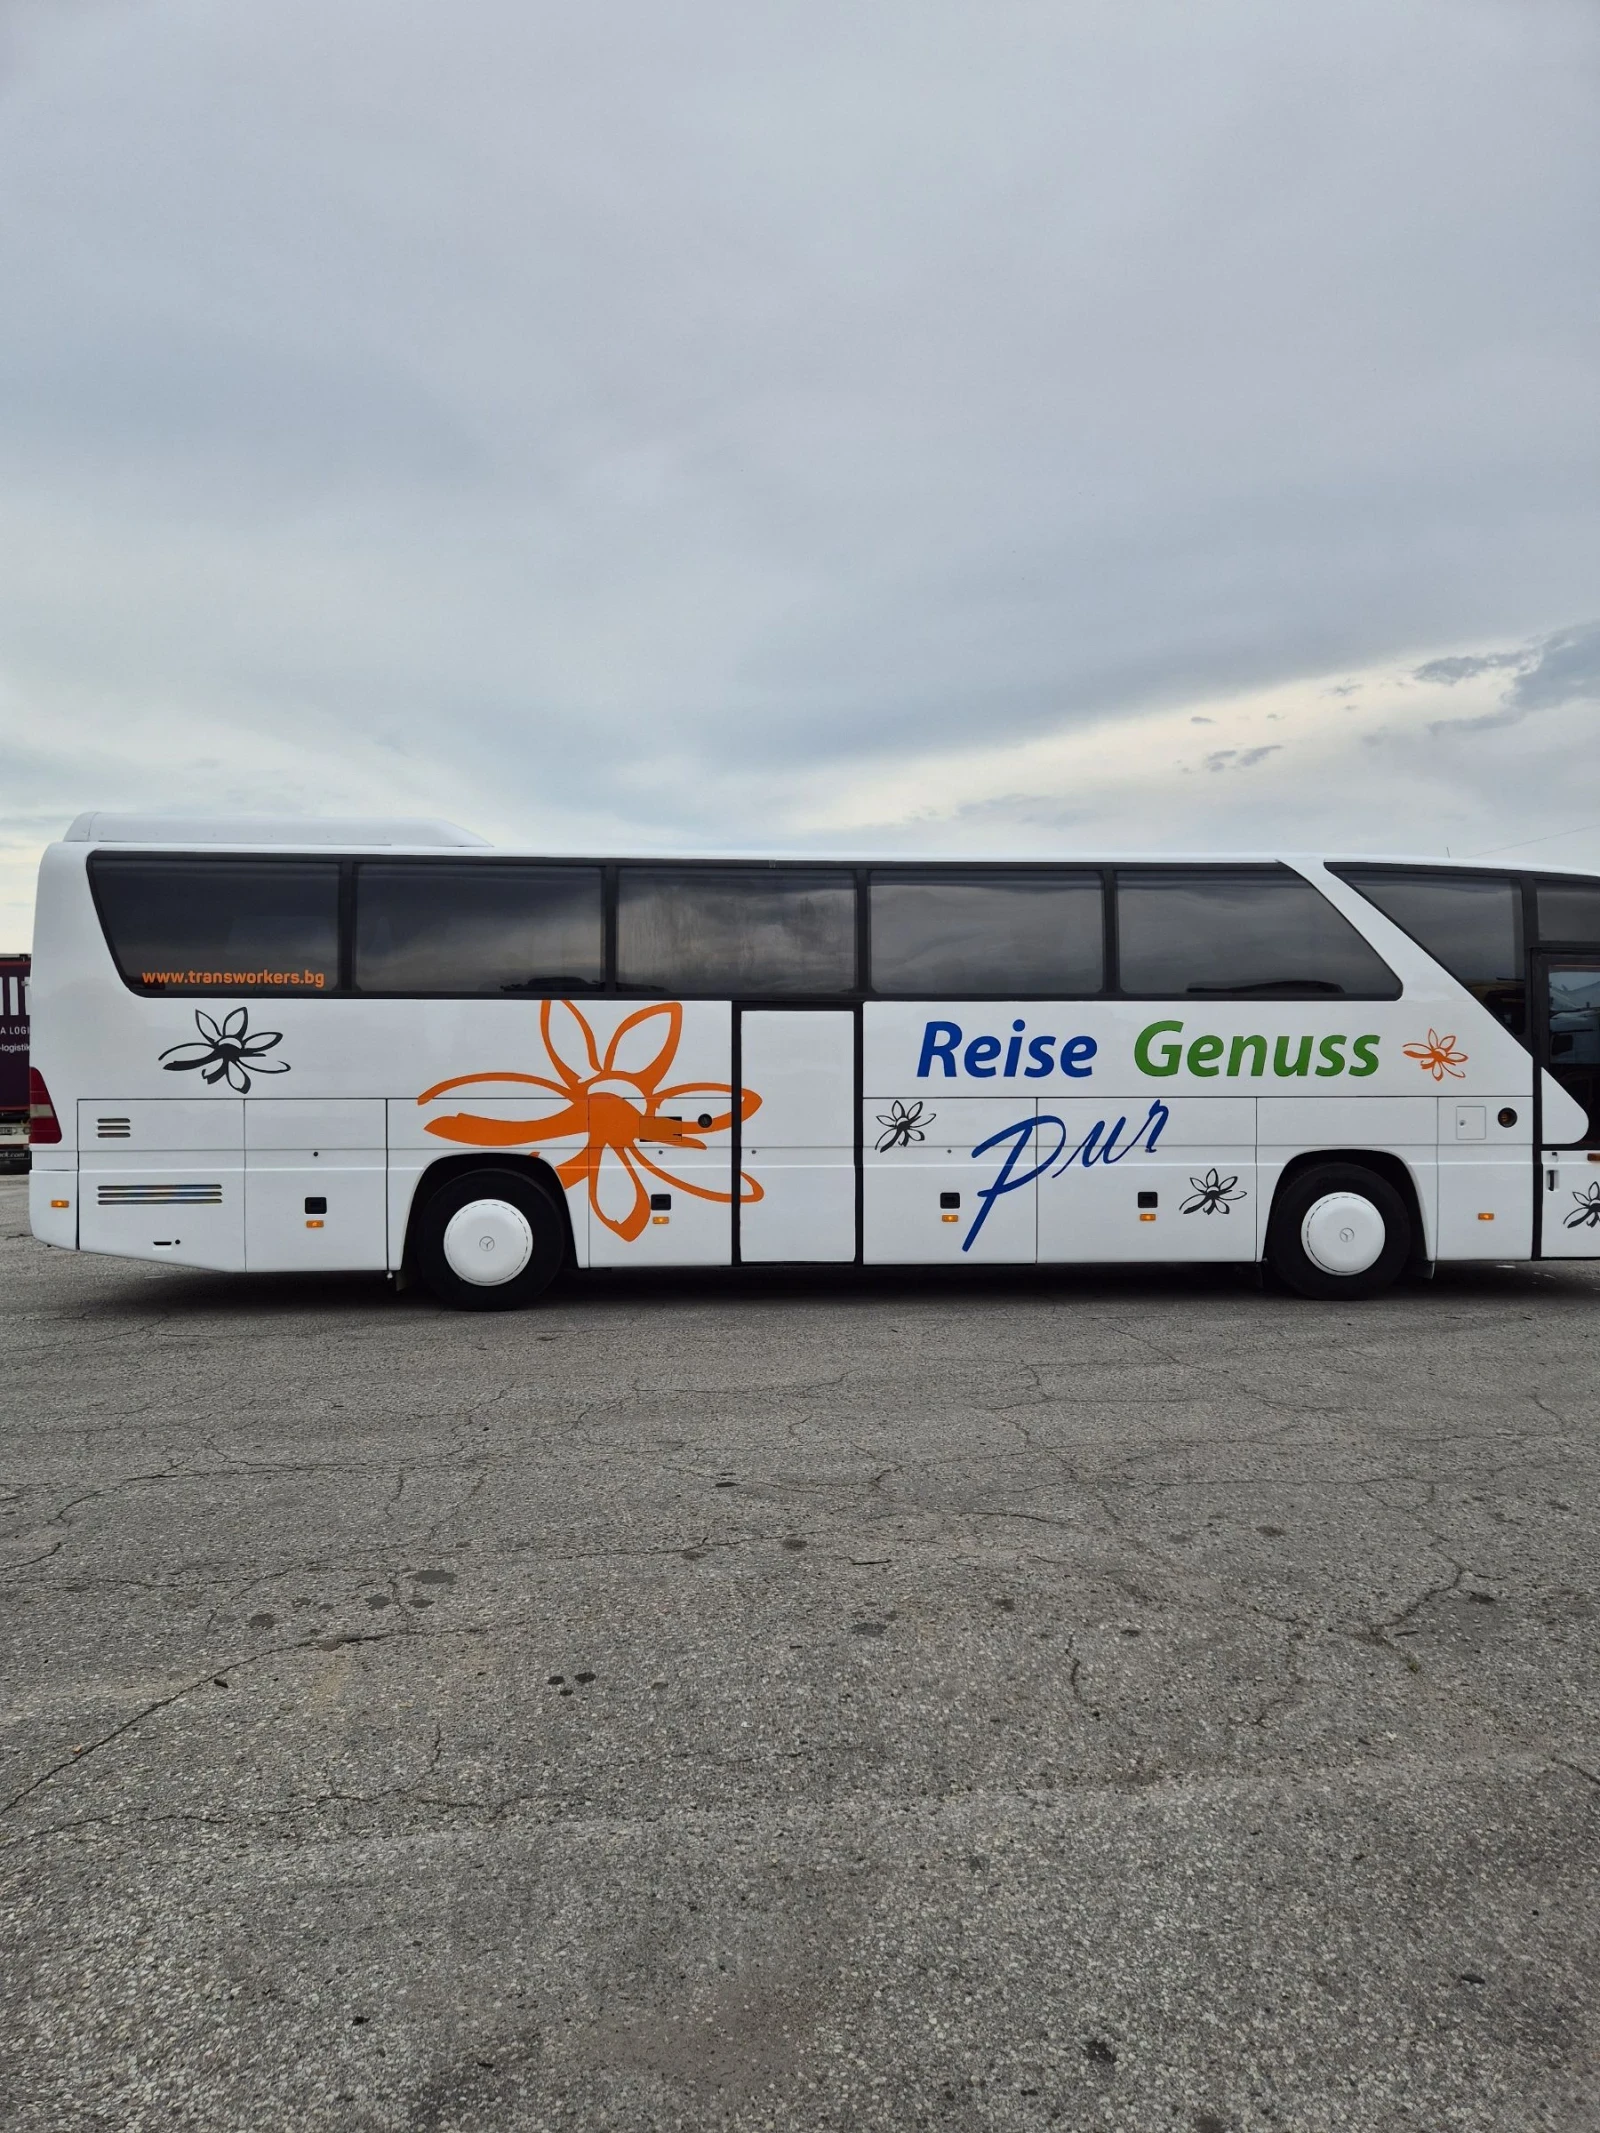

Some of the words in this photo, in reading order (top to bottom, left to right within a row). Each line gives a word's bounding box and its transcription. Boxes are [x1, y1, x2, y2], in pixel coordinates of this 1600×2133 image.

[142, 969, 325, 988] www.transworkers.bg
[917, 1019, 1097, 1078] Reise
[1134, 1020, 1379, 1078] Genuss
